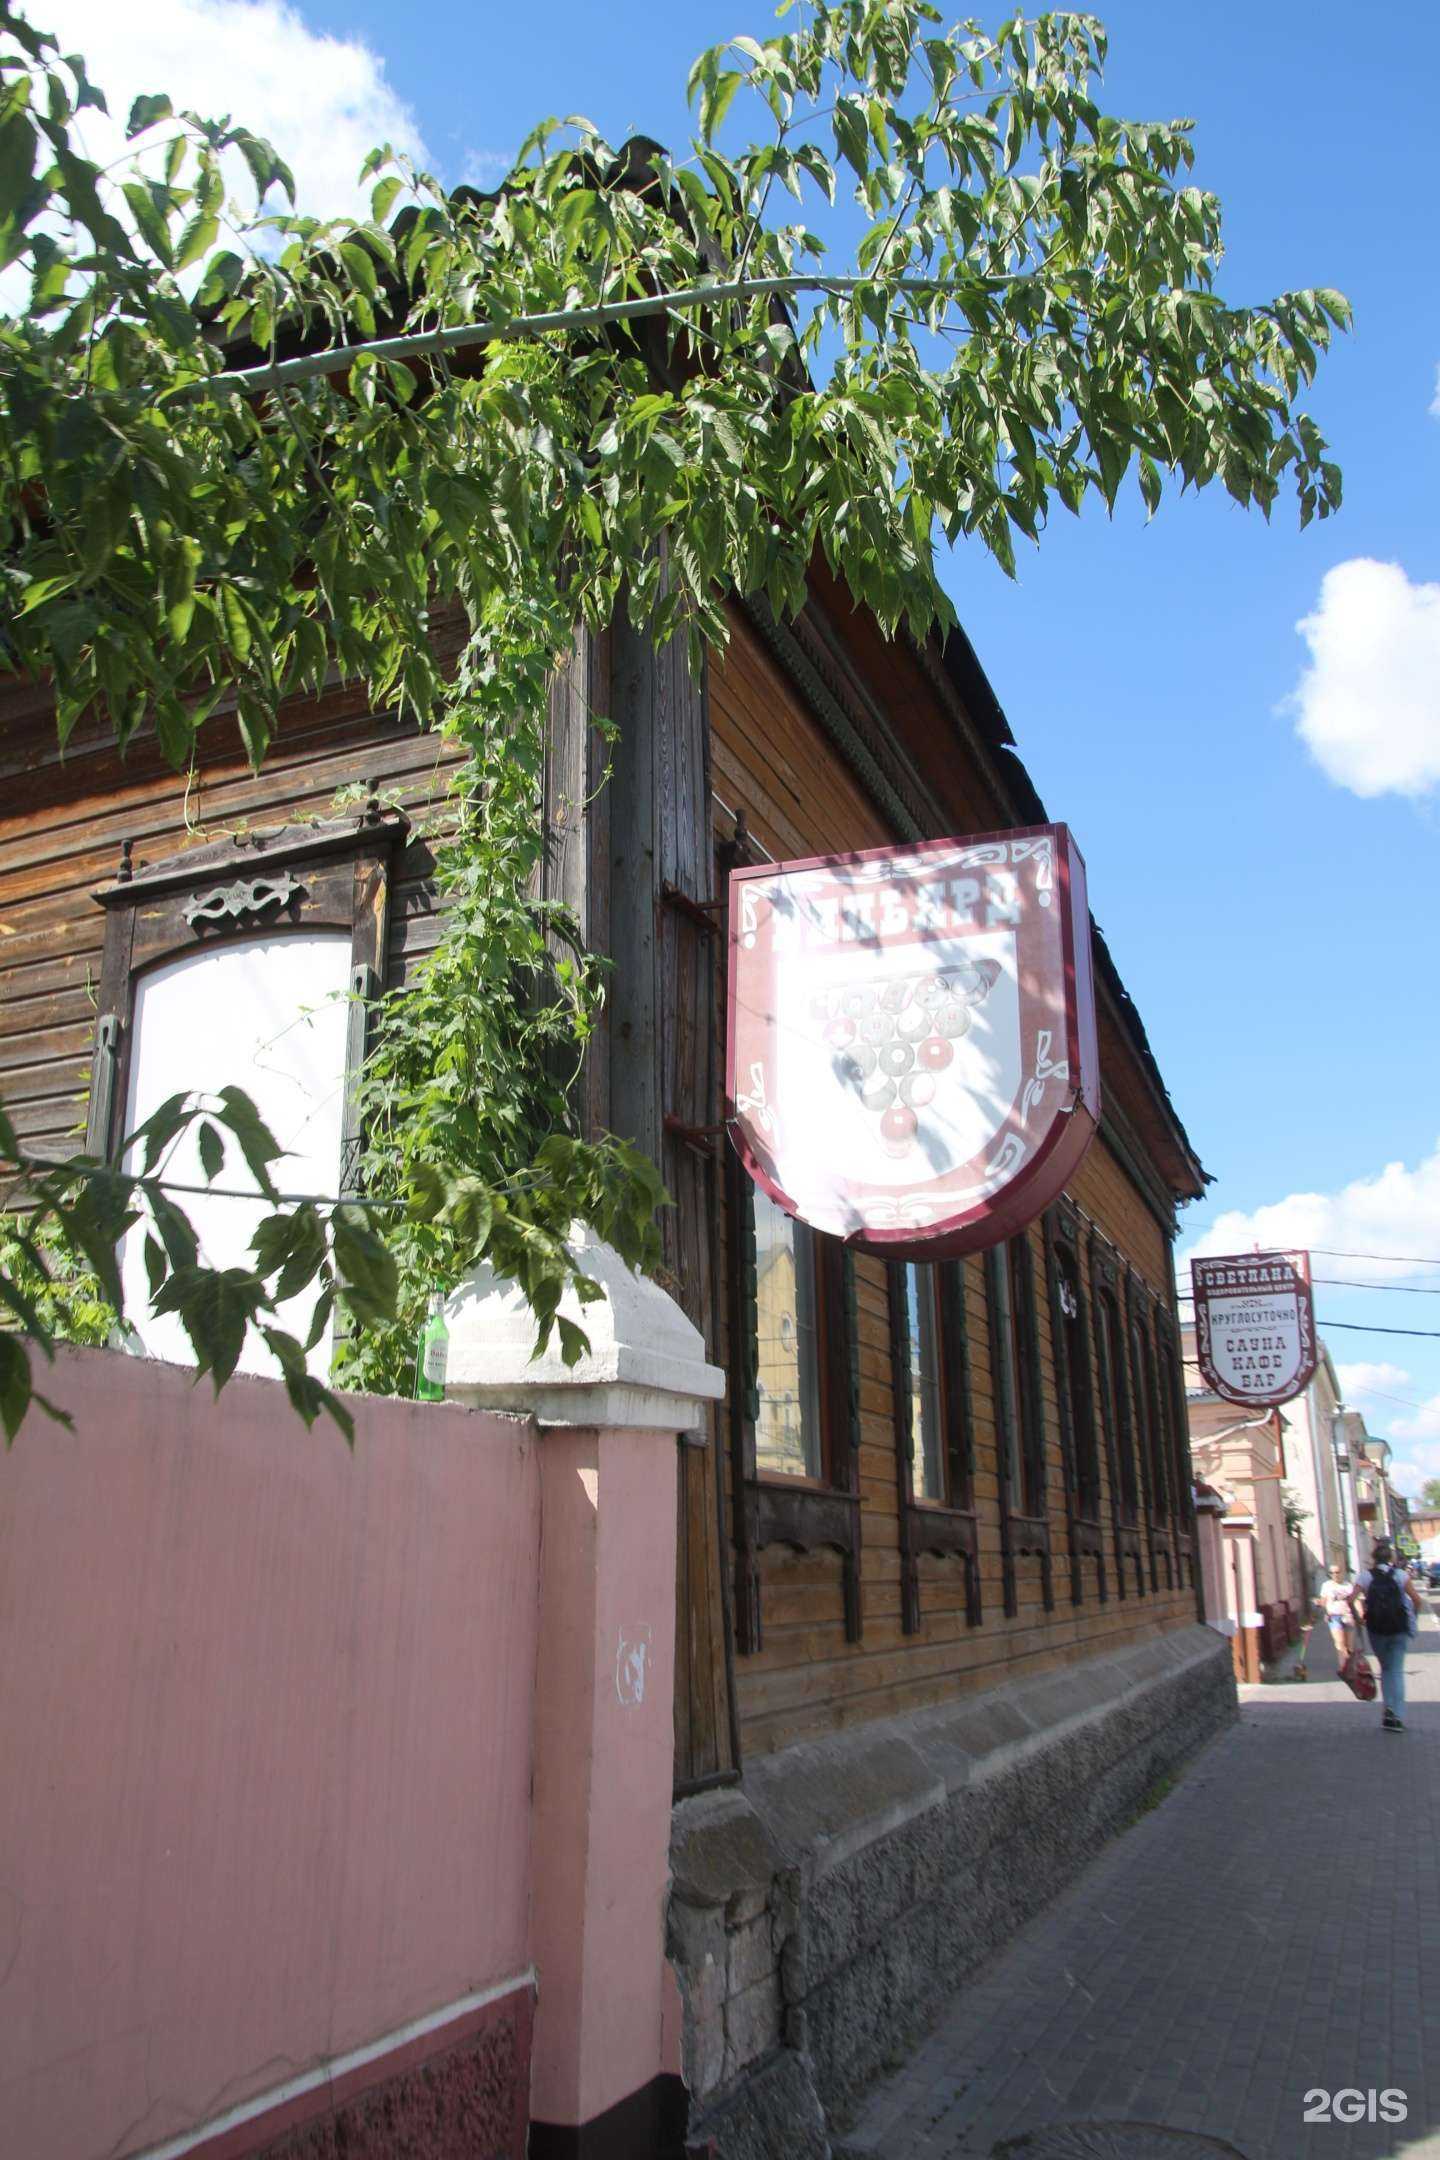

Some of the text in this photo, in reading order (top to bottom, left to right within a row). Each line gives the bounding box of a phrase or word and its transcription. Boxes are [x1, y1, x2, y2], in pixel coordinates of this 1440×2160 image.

[1205, 1266, 1294, 1286] СВЕТЛАНА
[1211, 1309, 1296, 1325] КРУГЛОСУТОЧНО
[1226, 1336, 1287, 1352] САУНА
[1232, 1354, 1282, 1370] КАФЕ
[1242, 1373, 1275, 1387] БАР
